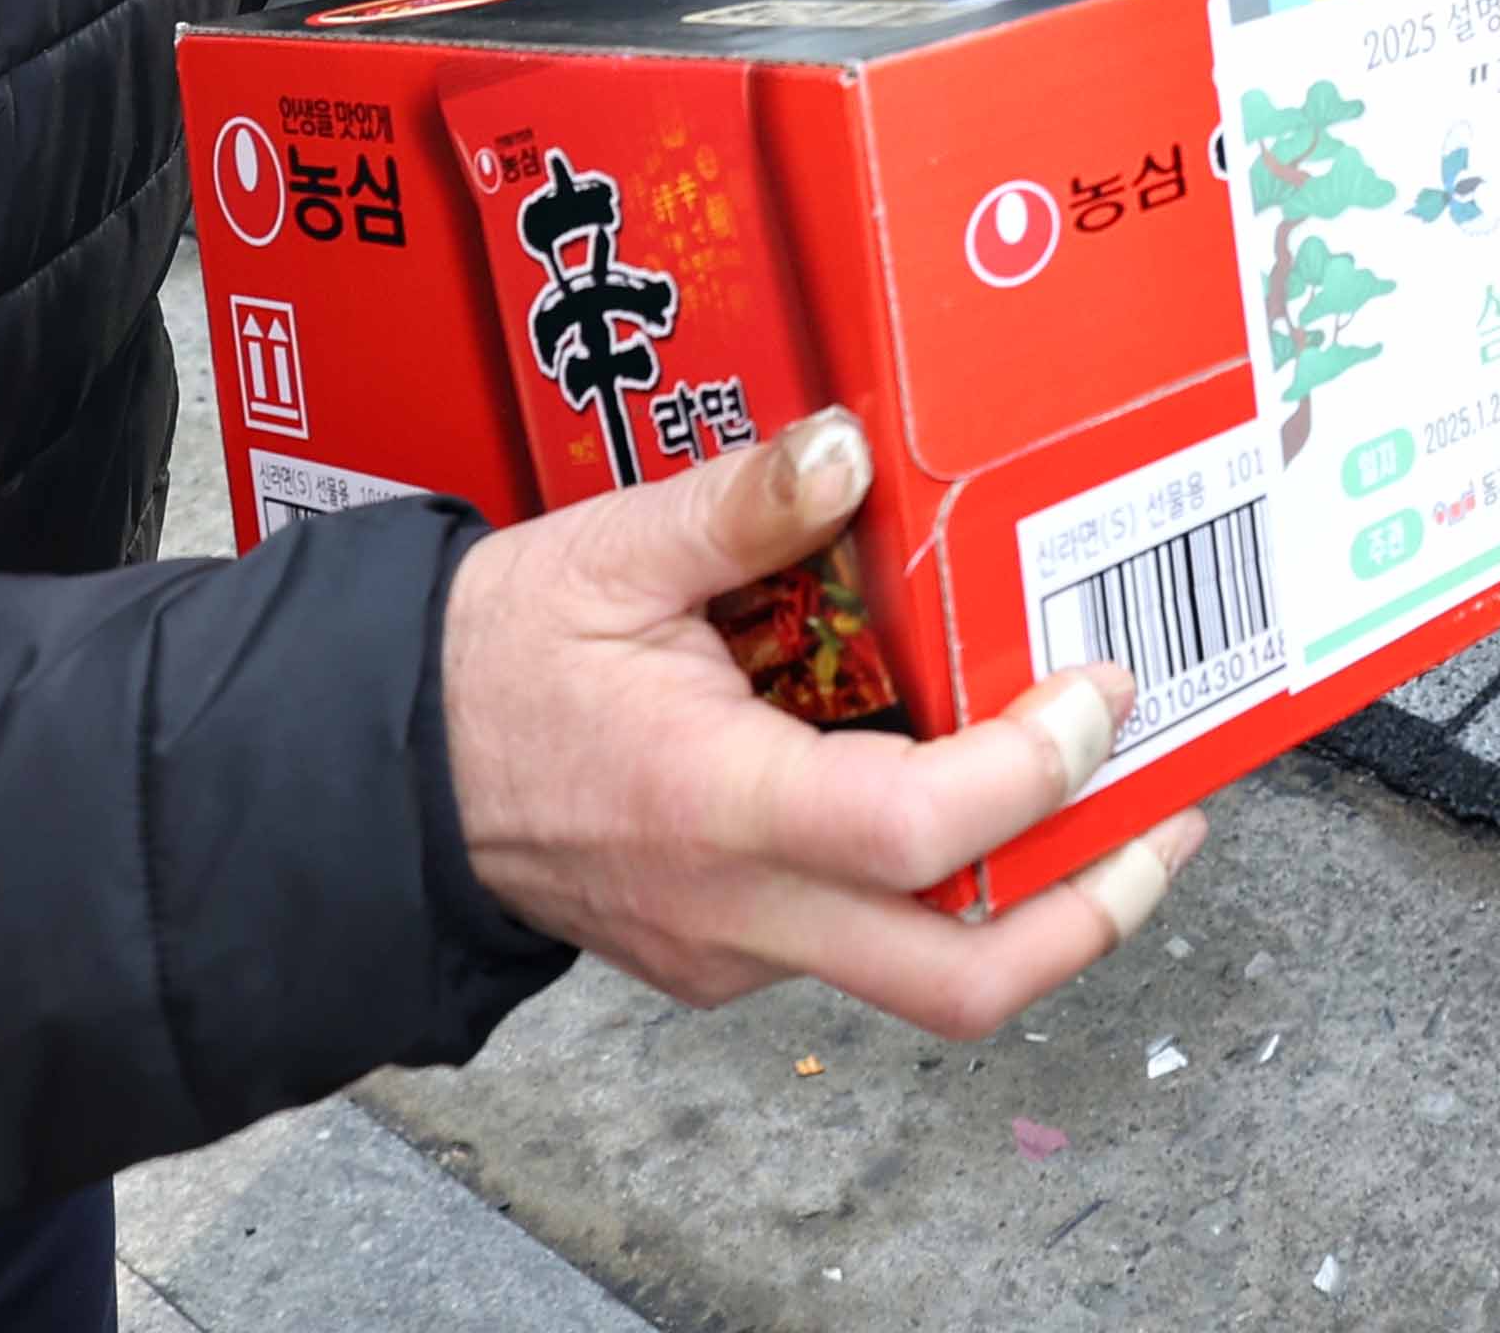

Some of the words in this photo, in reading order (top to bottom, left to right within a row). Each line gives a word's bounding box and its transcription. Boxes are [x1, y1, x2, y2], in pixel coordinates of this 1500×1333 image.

[1363, 13, 1437, 71] 2025
[278, 95, 333, 139] 인생을
[334, 102, 395, 144] 맛있게
[286, 144, 406, 247] 농심
[1069, 144, 1186, 232] 농심
[518, 148, 679, 489] 辛
[650, 376, 757, 465] 라면
[259, 460, 314, 501] 신라면(S)
[316, 475, 350, 508] 선물용
[1036, 499, 1138, 580] 신라면(S)
[1146, 470, 1206, 530] 선물용
